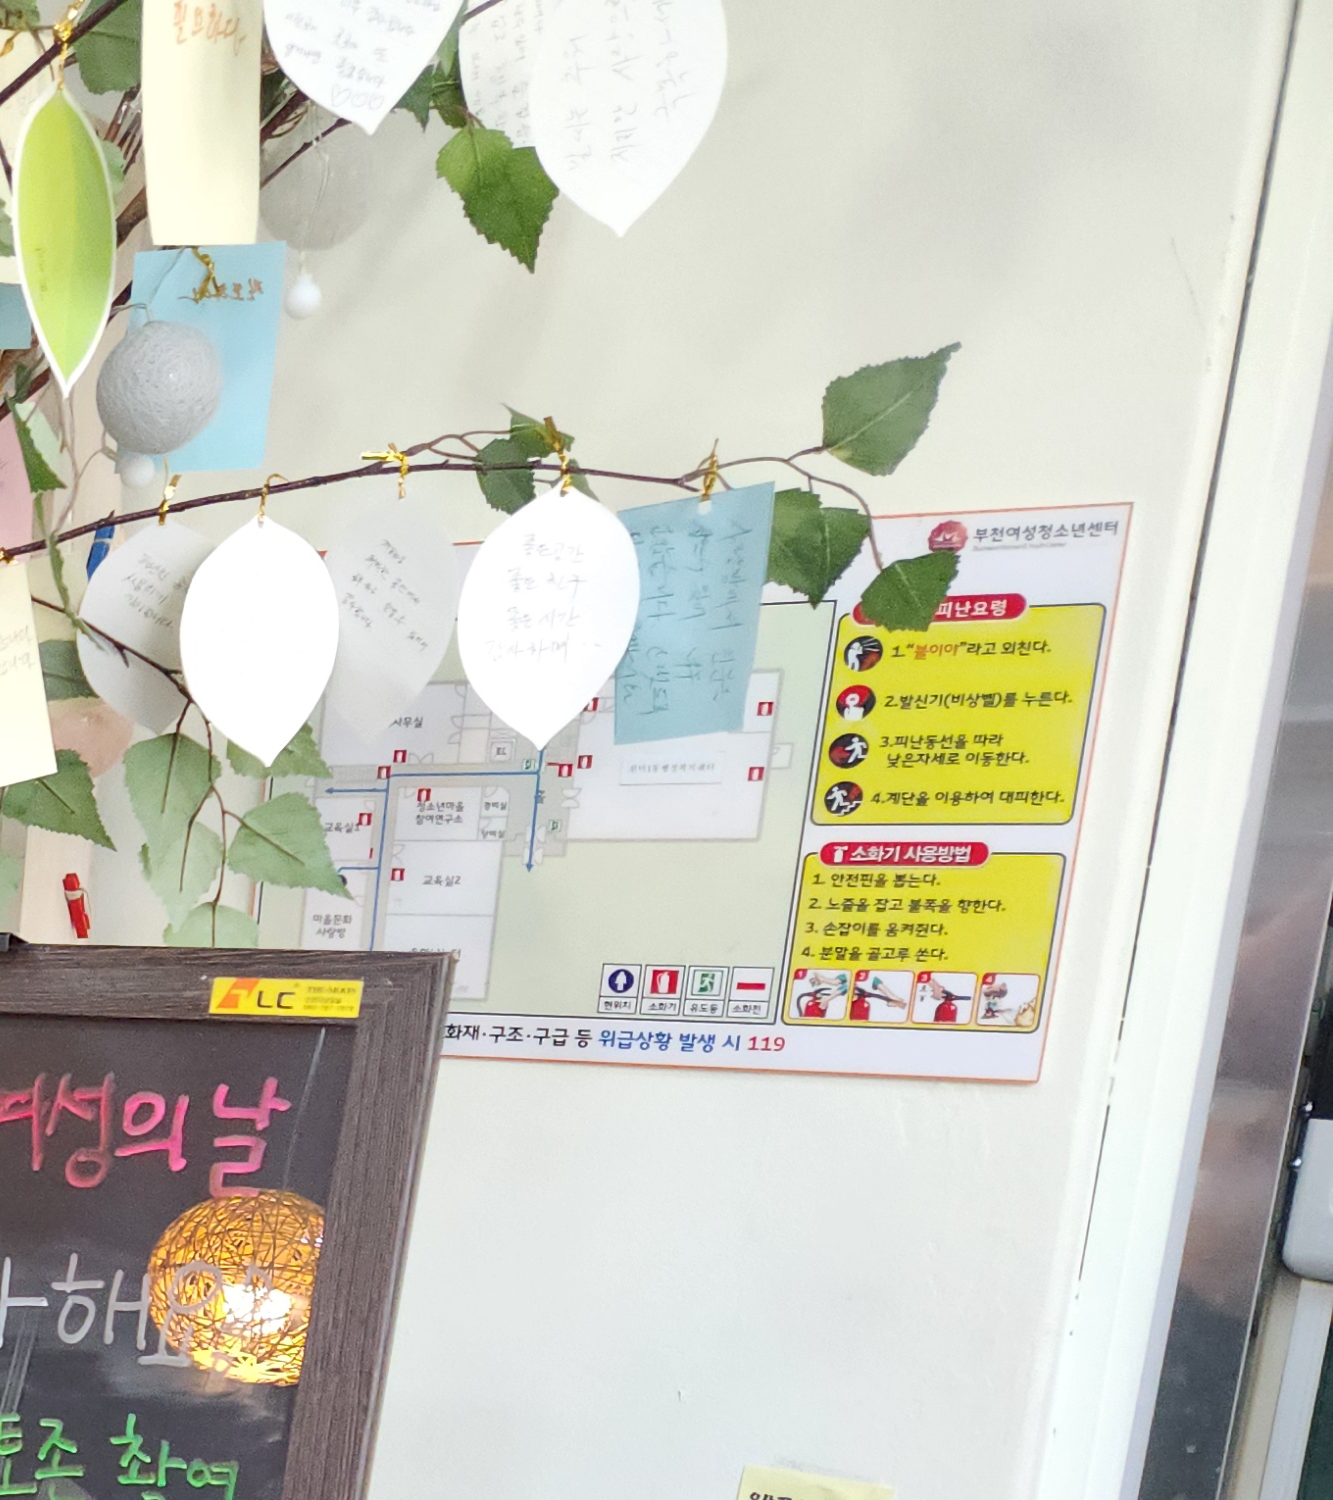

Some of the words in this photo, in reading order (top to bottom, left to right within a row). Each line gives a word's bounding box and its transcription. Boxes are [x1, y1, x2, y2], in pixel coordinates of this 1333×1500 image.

[973, 520, 1119, 543] 부천여성청소년센터
[934, 600, 1008, 619] 피난요령
[388, 716, 423, 729] 사무실
[973, 733, 1003, 747] 따라
[849, 845, 901, 862] 소화기
[903, 844, 973, 862] 사용방법
[423, 875, 462, 887] 교육실2
[831, 873, 888, 888] 안전핀을
[574, 1028, 593, 1048] 등
[599, 1030, 672, 1050] 위급상황
[679, 1033, 716, 1053] 발생
[721, 1035, 741, 1052] 시
[747, 1035, 786, 1052] 119
